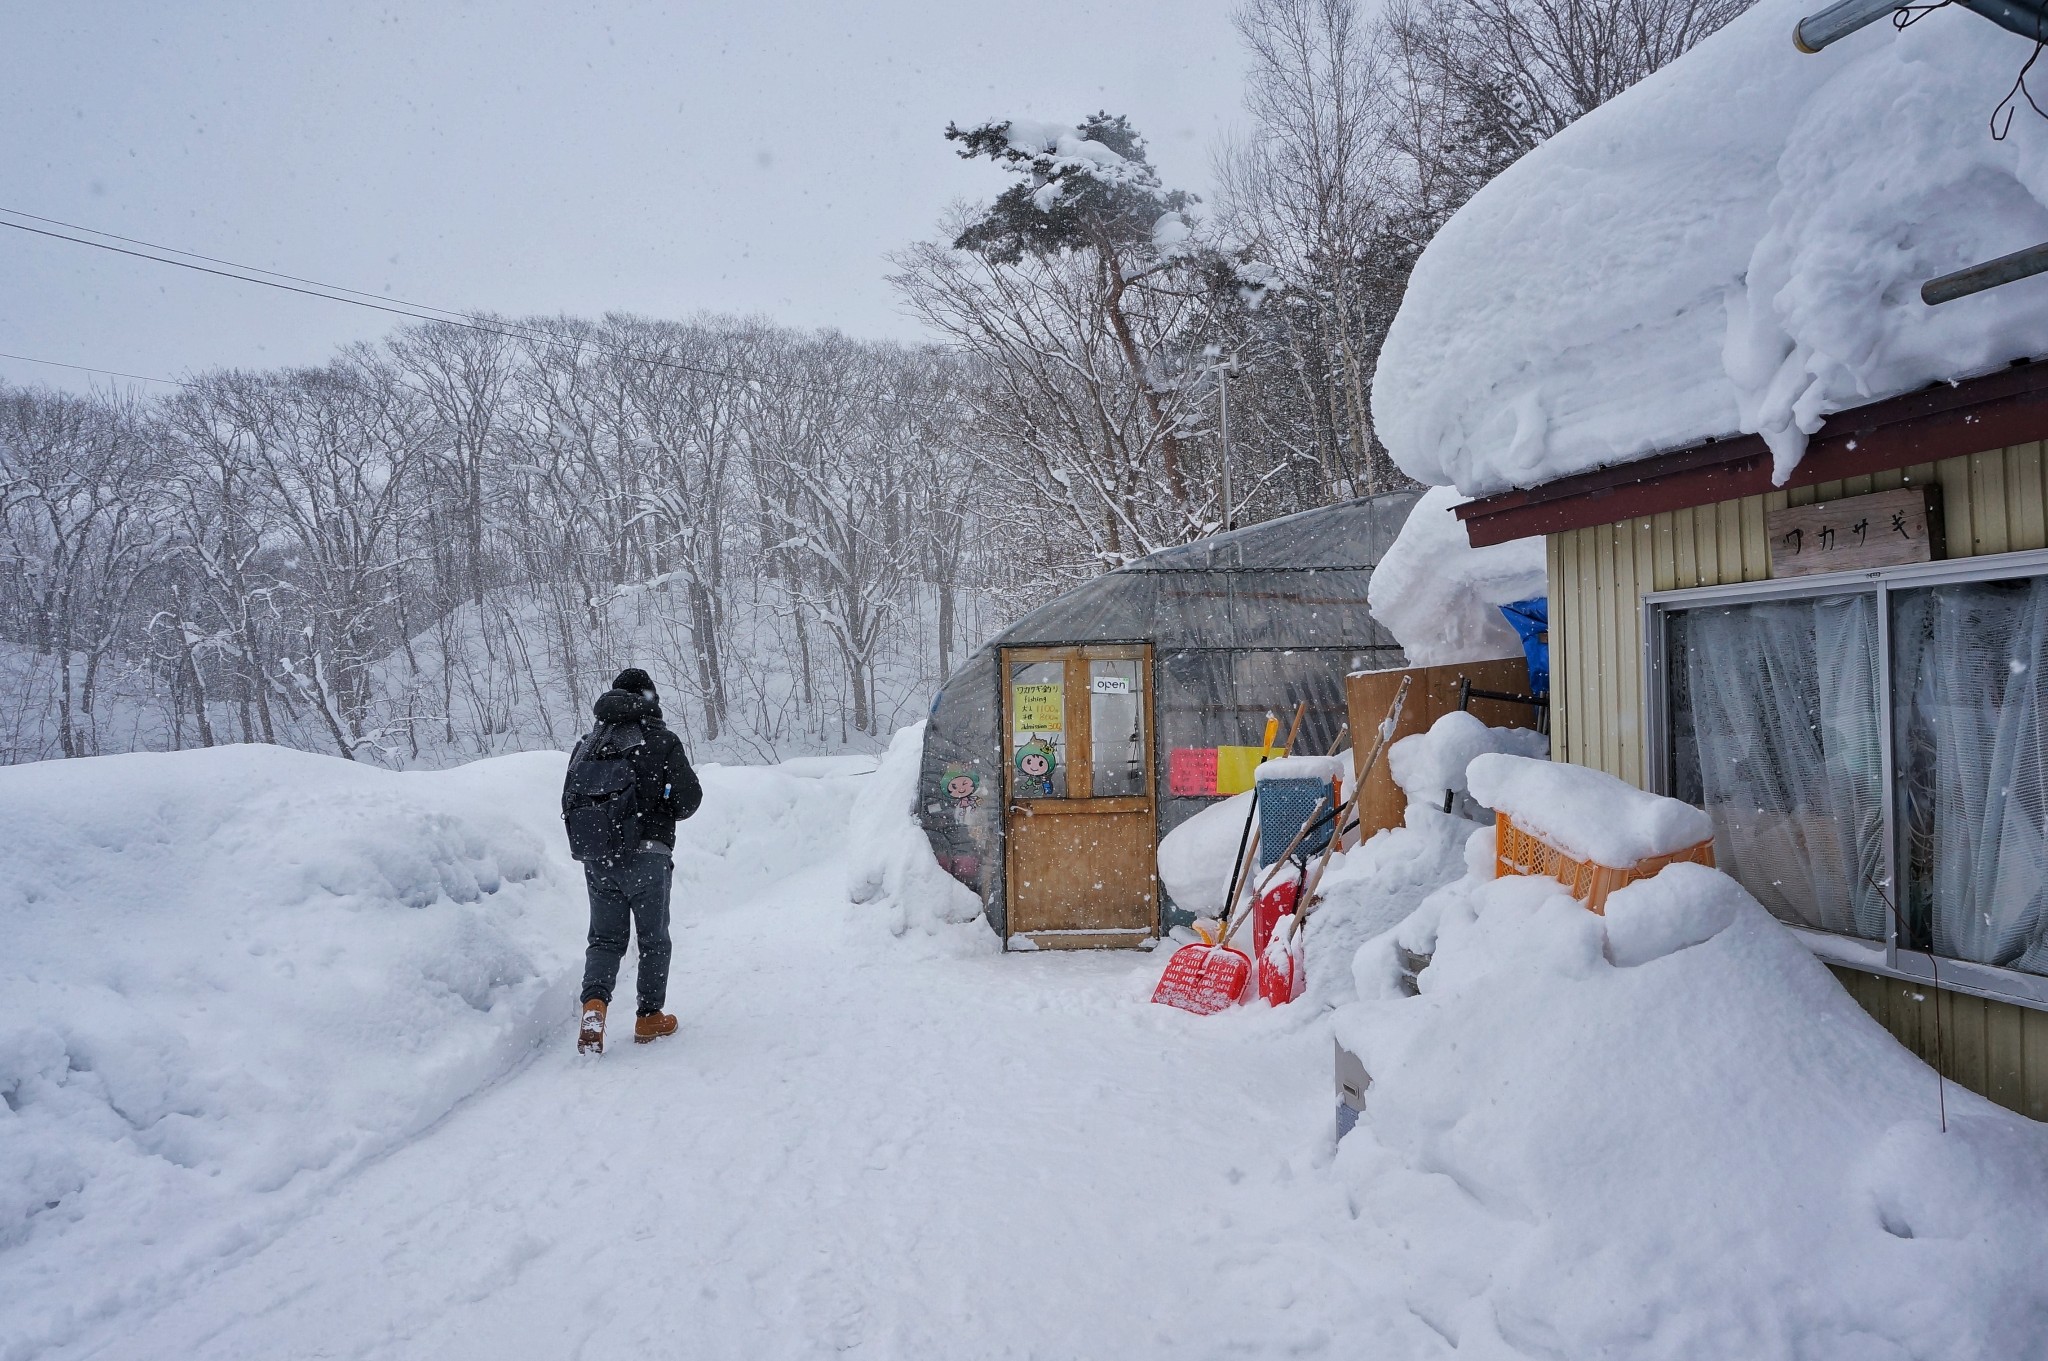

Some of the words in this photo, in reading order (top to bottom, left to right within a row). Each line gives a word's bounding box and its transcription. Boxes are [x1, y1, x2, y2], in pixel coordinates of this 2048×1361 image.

[1785, 510, 1910, 555] ワカサギ
[1097, 680, 1126, 691] open
[1024, 695, 1047, 703] fishing
